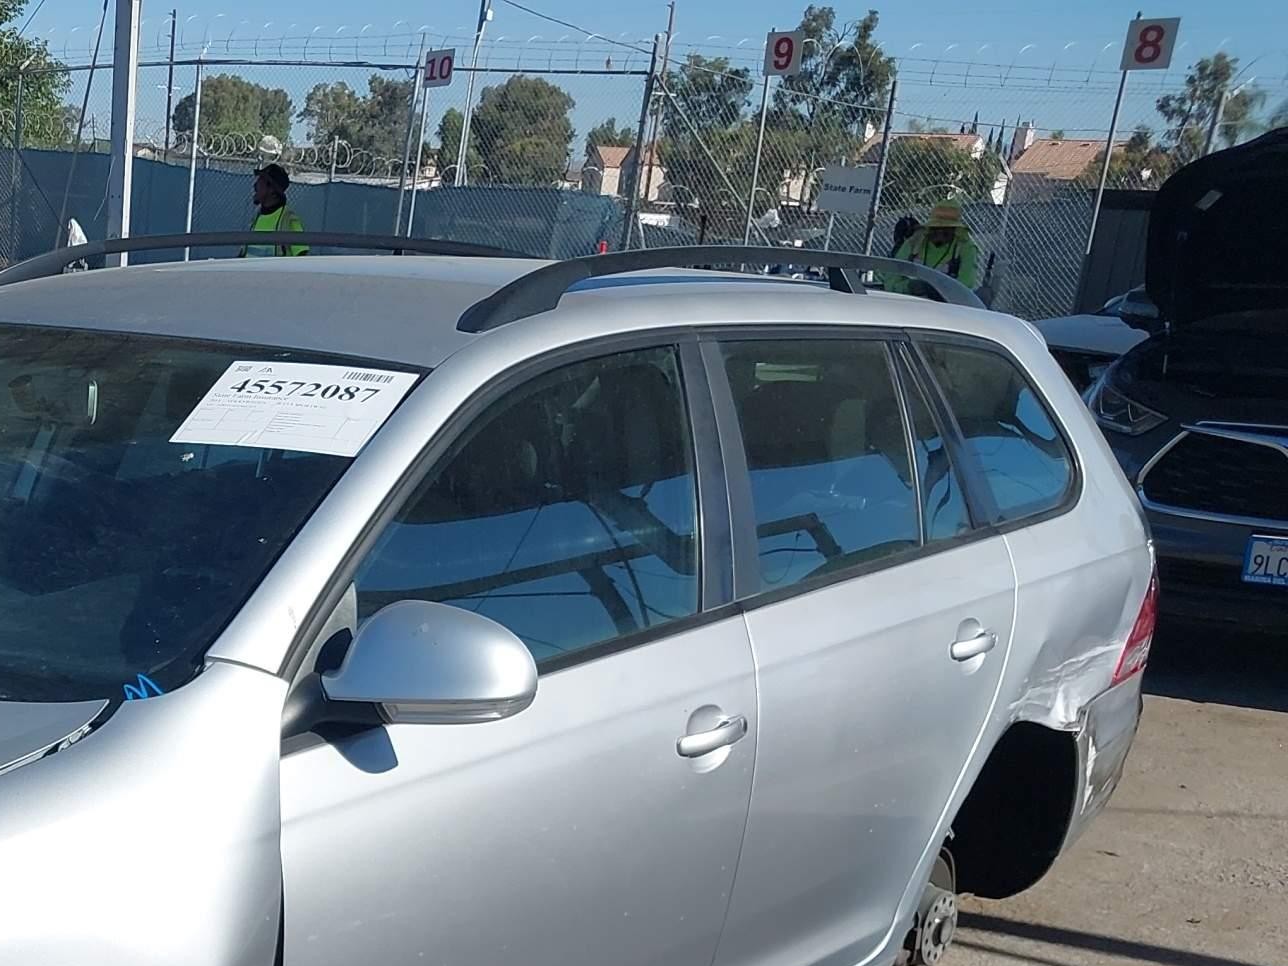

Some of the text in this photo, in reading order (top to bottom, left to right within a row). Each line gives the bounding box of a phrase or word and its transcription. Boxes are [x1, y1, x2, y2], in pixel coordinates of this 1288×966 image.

[773, 36, 794, 70] 9
[1134, 24, 1165, 64] 8
[425, 55, 453, 81] 10
[823, 183, 872, 195] State Farm
[229, 378, 381, 403] 45572087
